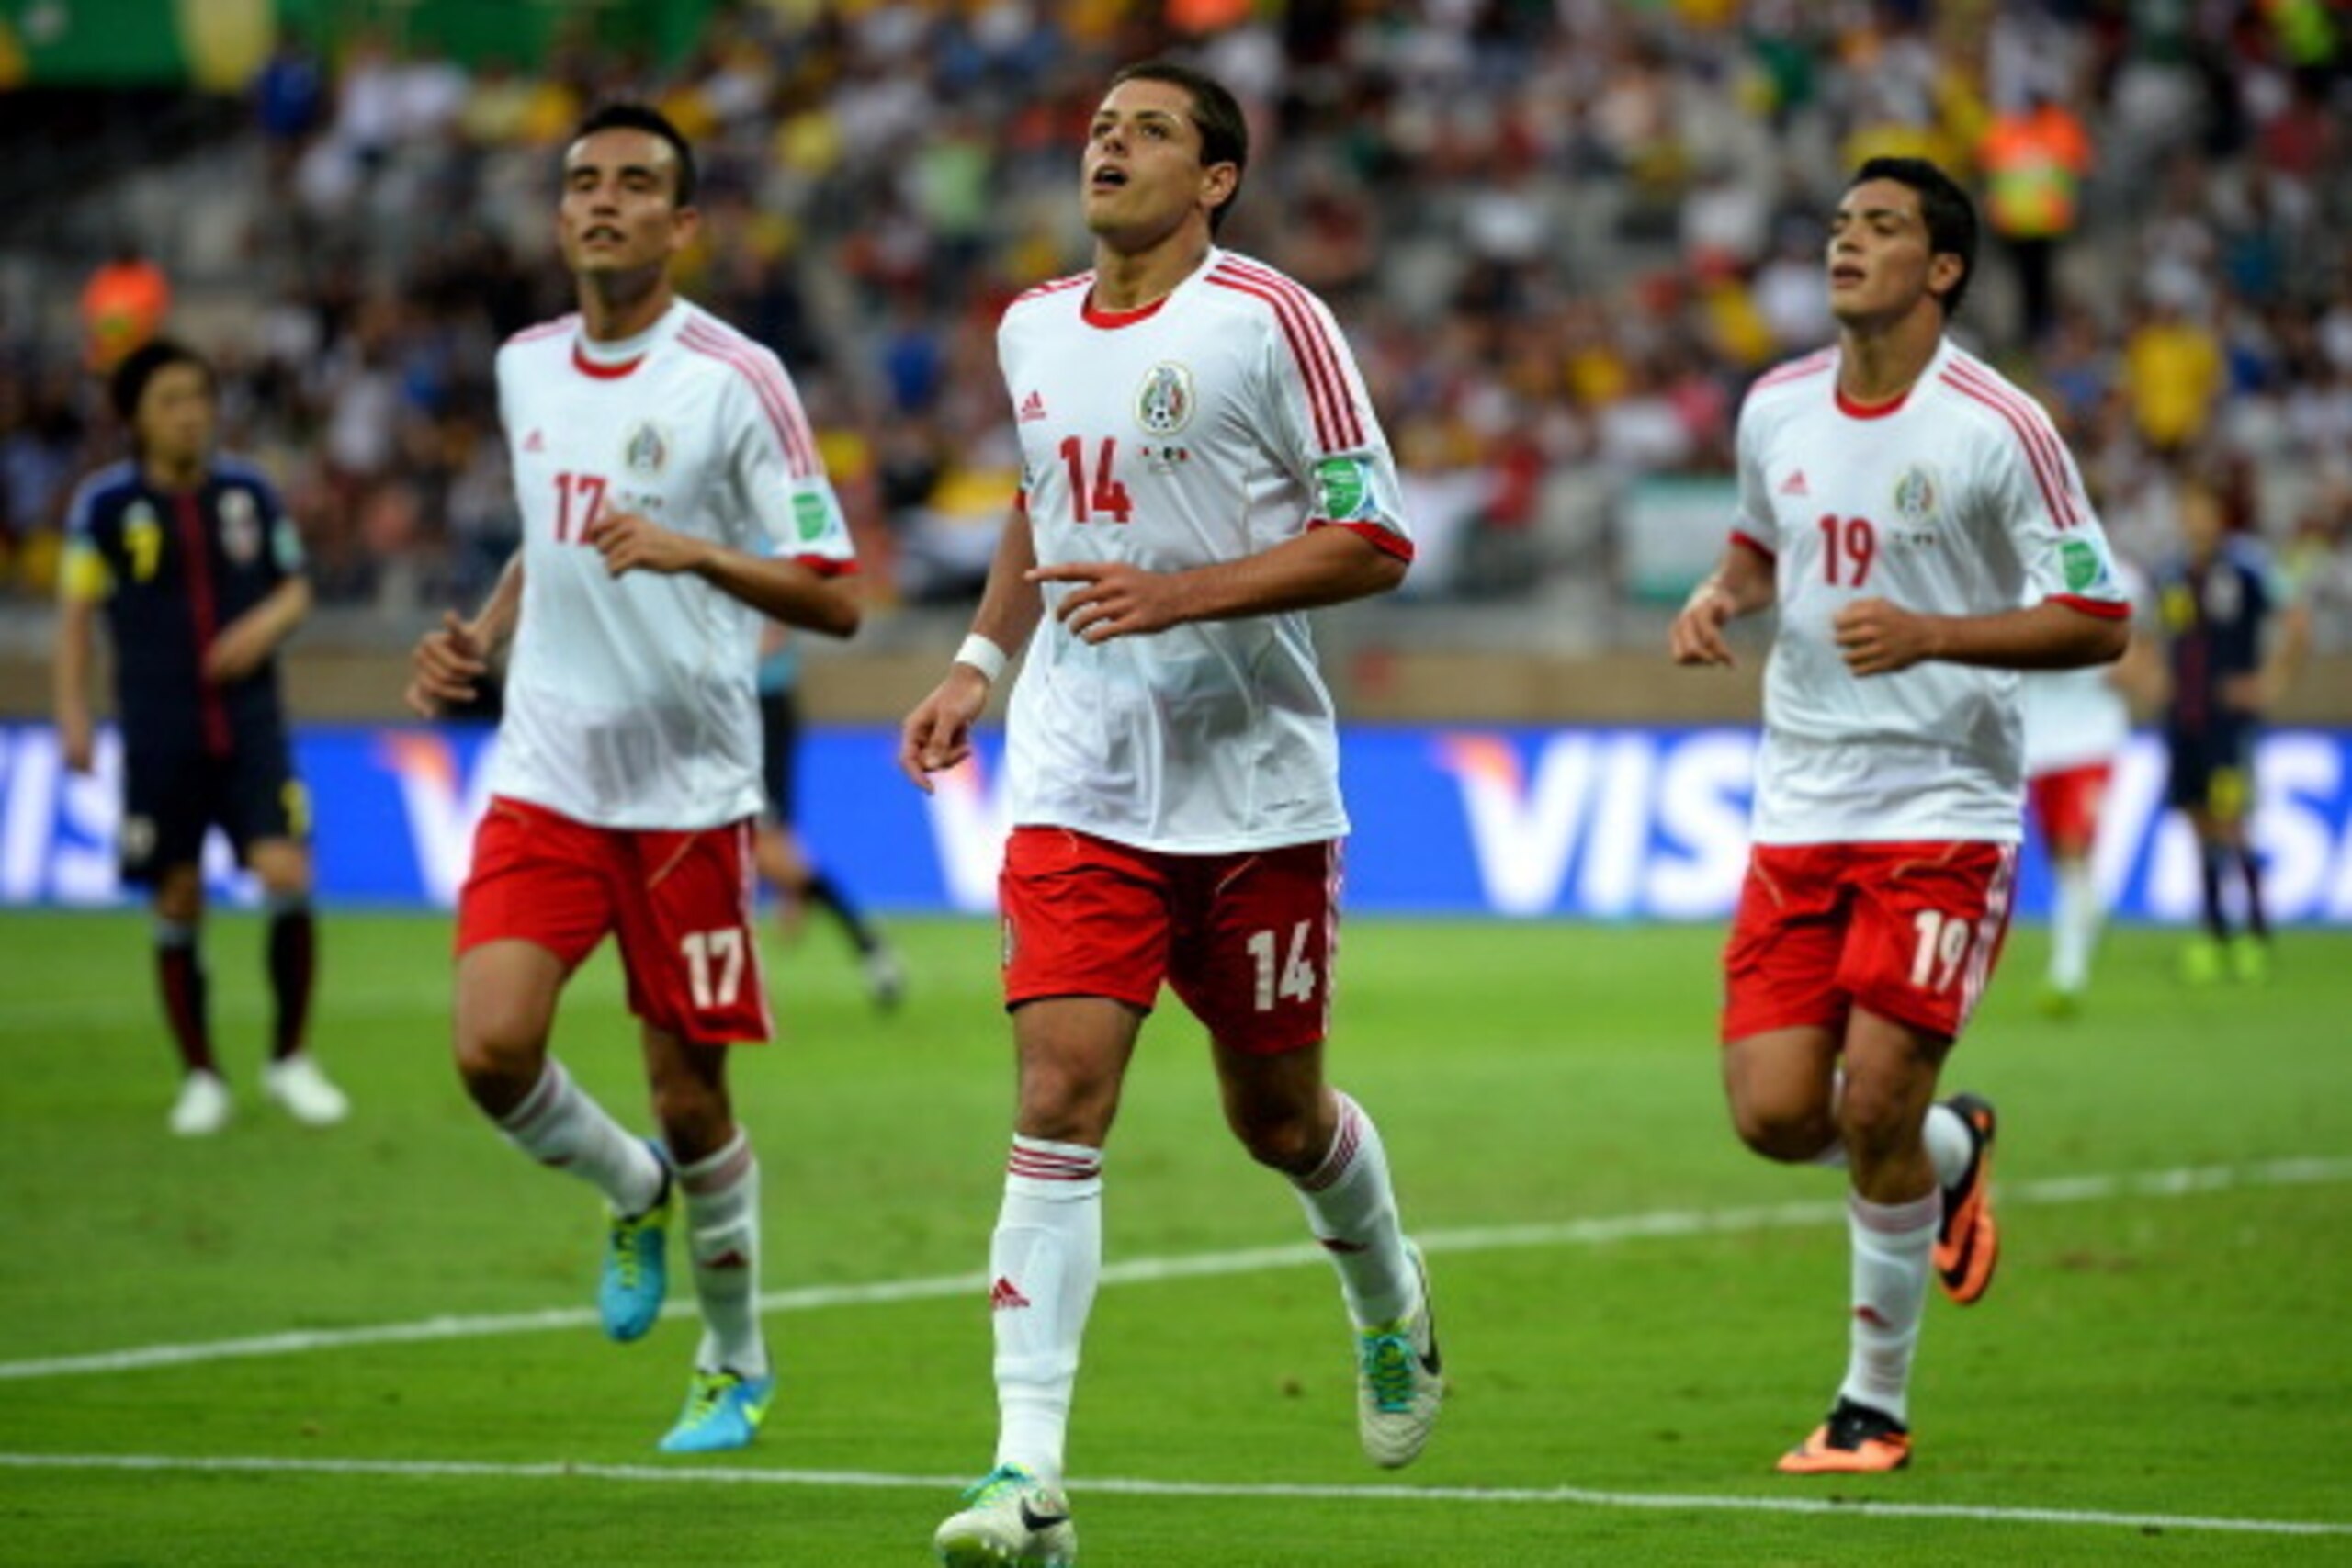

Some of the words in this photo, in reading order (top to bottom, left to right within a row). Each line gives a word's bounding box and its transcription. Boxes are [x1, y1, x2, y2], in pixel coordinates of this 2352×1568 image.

[554, 473, 606, 545] 17
[1060, 435, 1132, 524] 14
[1819, 514, 1874, 589] 19
[1435, 728, 1757, 919] VIS
[681, 927, 743, 1010] 17
[1247, 919, 1316, 1010] 14
[1913, 908, 1968, 994] 19
